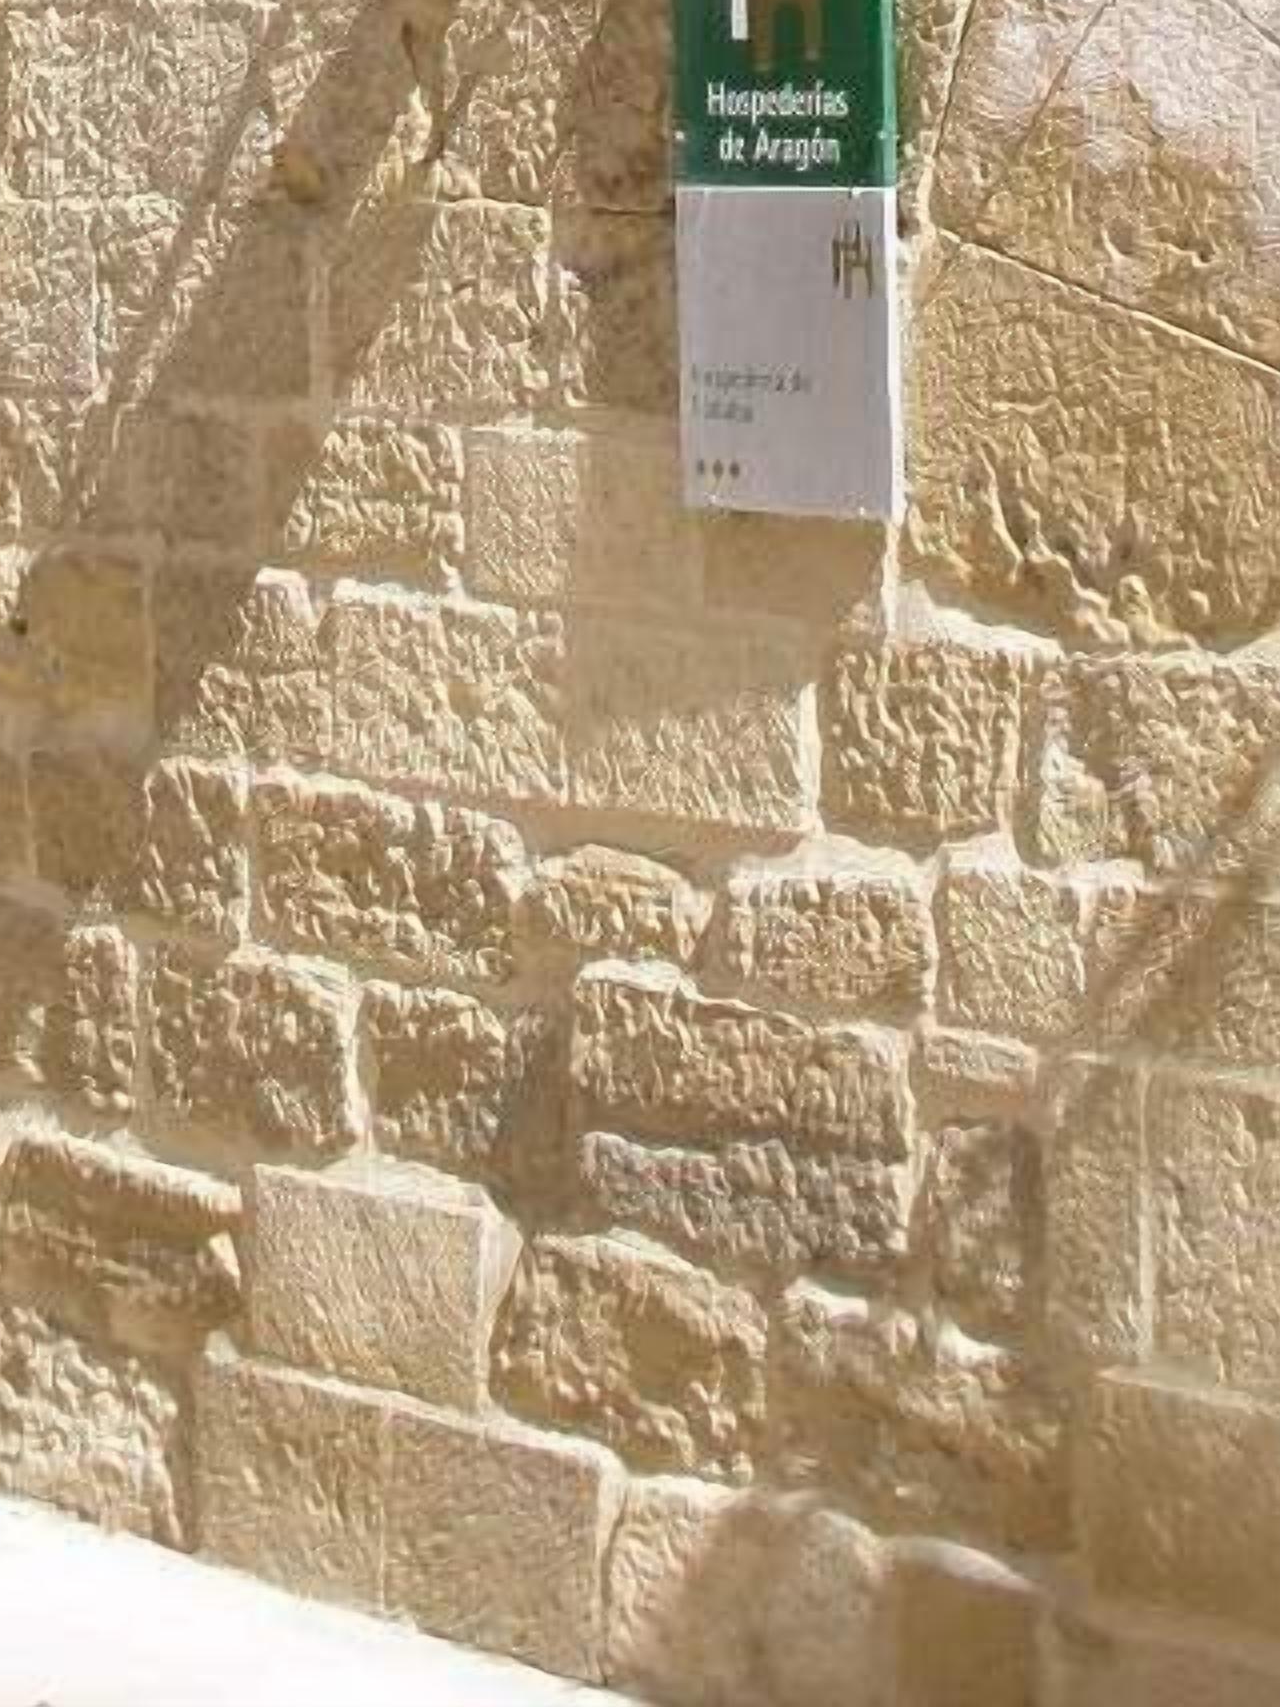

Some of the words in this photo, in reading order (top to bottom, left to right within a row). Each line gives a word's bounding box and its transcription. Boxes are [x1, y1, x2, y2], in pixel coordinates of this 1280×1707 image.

[707, 79, 849, 126] Hospederías
[719, 129, 746, 162] de
[753, 128, 841, 171] Aragón
